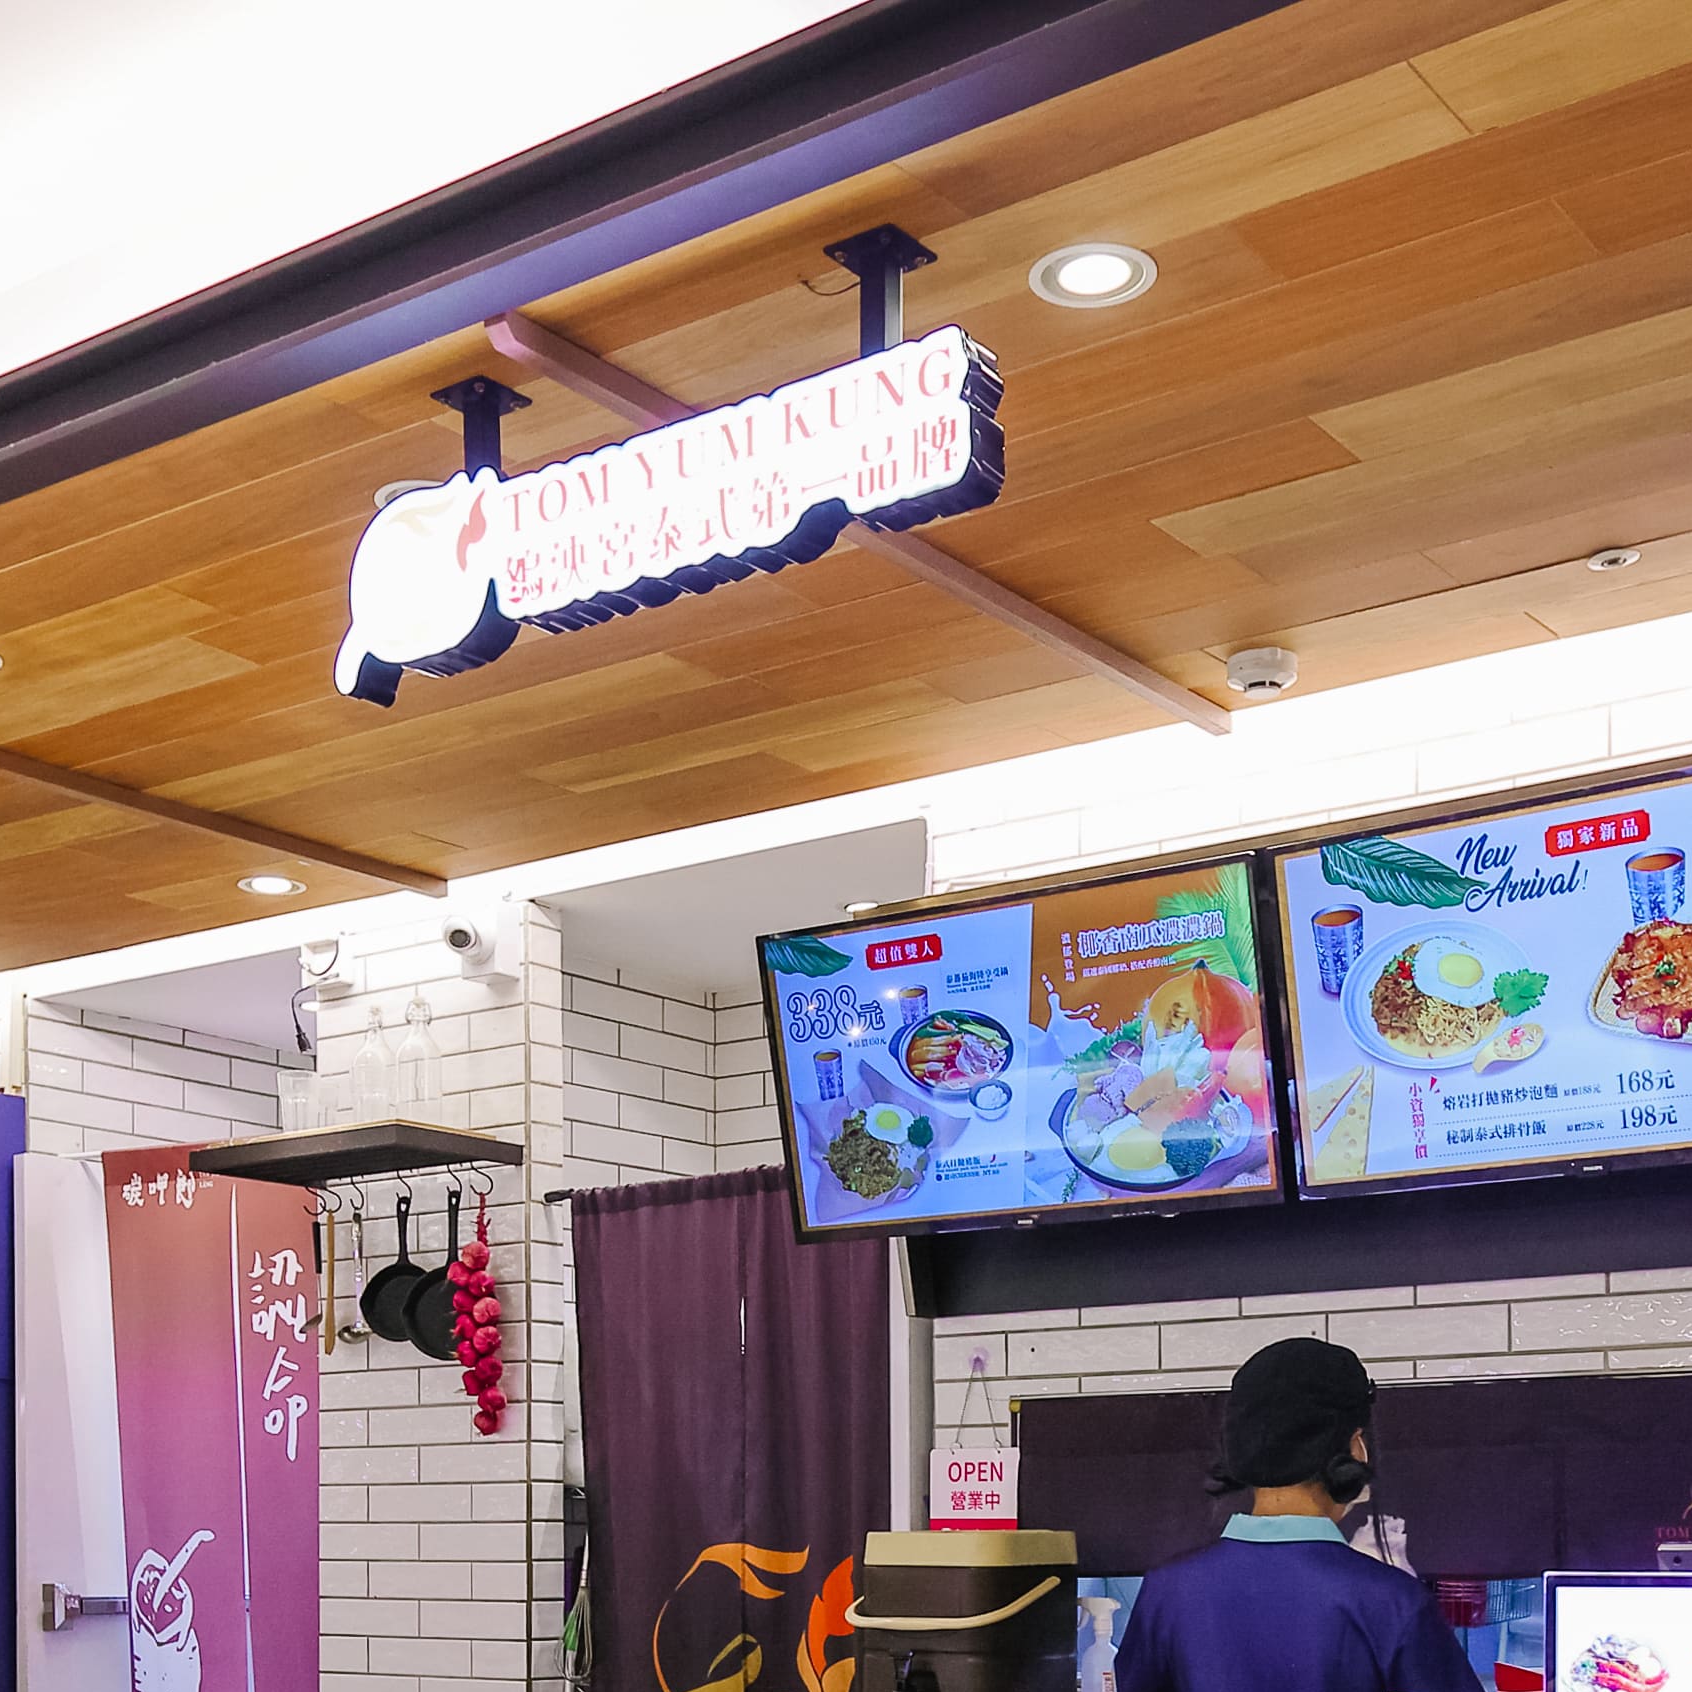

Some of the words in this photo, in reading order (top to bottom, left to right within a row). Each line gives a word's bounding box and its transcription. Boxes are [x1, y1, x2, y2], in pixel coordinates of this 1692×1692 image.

[503, 461, 610, 532] TOM
[636, 415, 755, 491] YUM
[782, 346, 954, 446] KUNG
[1556, 817, 1640, 850] 獨家新品
[1456, 833, 1517, 875] New
[873, 942, 935, 965] 超值雙人
[787, 984, 886, 1043] 338元
[1616, 1068, 1676, 1095] 168元
[1620, 1103, 1679, 1130] 198元
[948, 1462, 1003, 1482] OPEN
[951, 1490, 1000, 1511] 營業中
